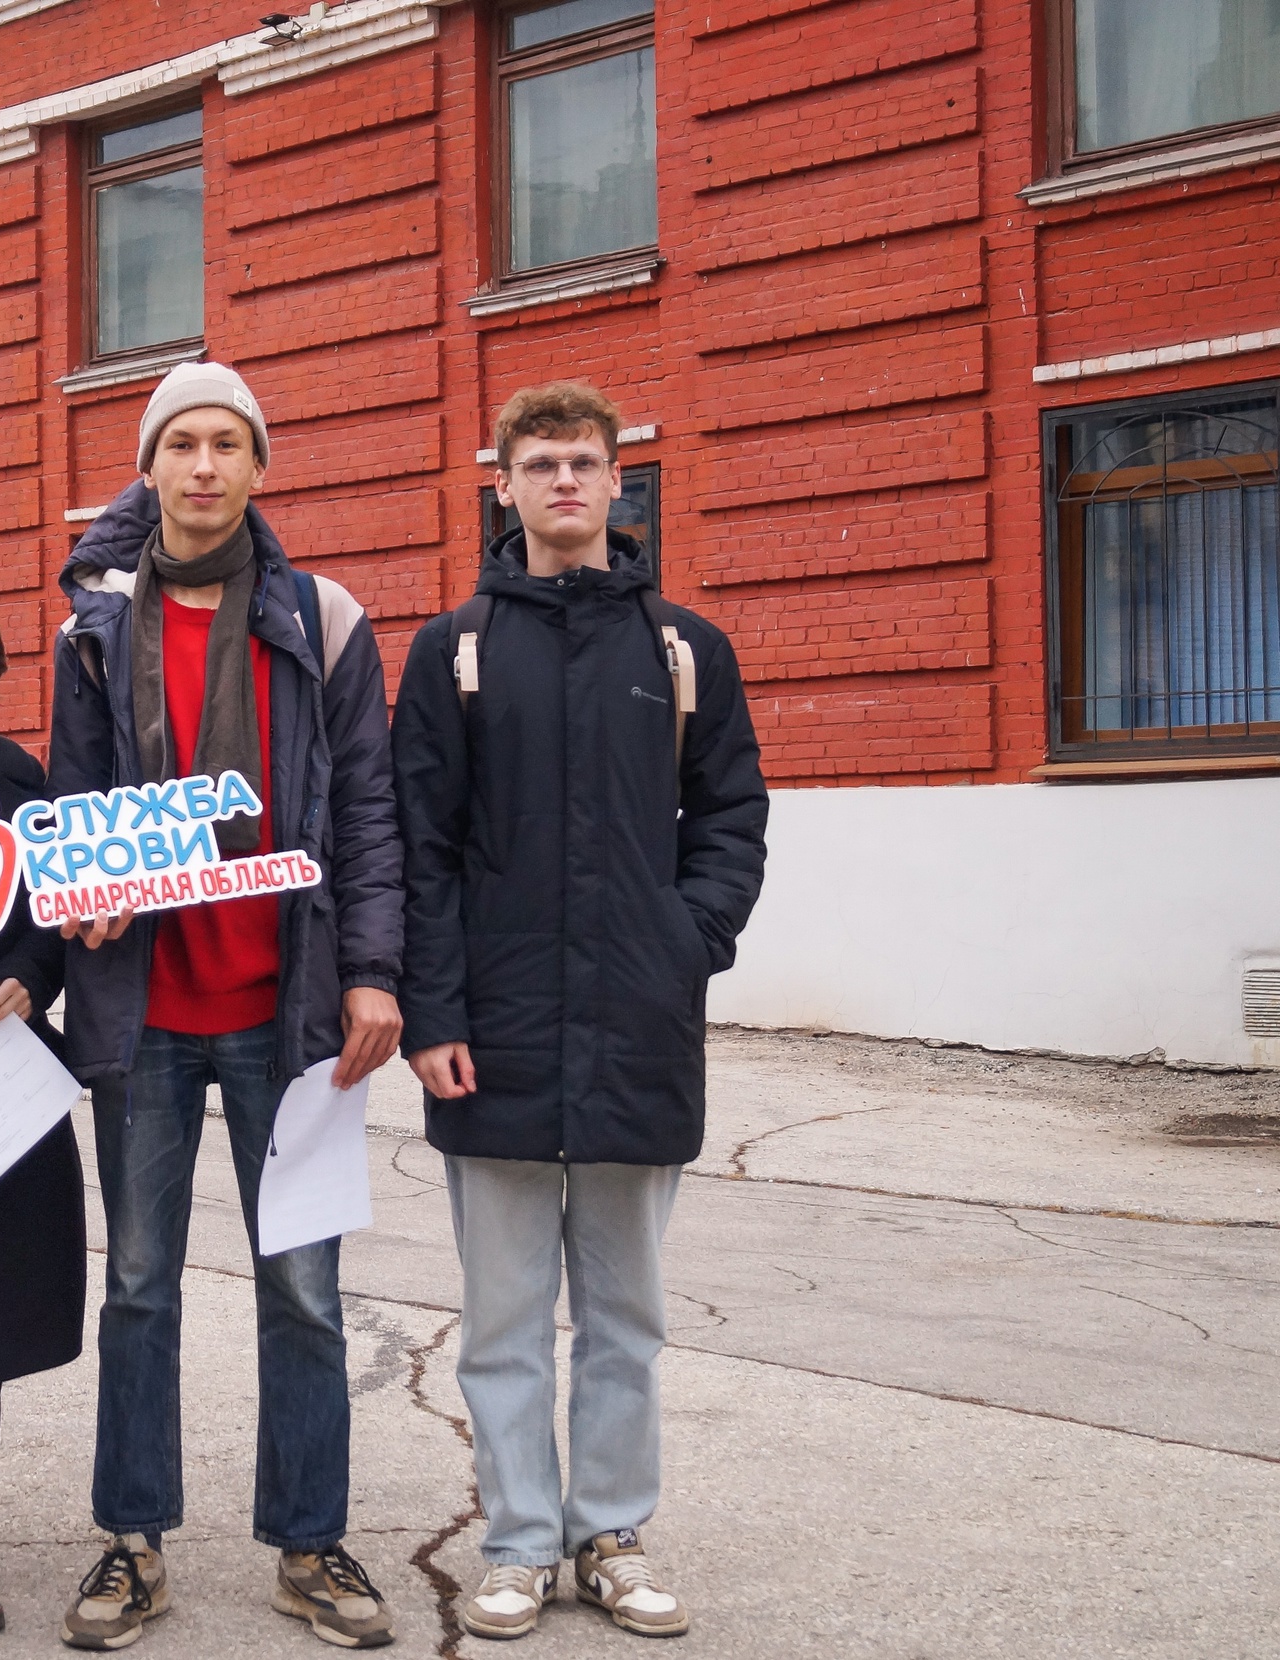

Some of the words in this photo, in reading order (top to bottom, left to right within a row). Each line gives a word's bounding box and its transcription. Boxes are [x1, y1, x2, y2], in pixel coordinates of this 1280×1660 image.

[20, 775, 257, 843] СЛУЖБА
[26, 823, 213, 888] КРОВИ
[36, 871, 195, 922] САМАРСКАЯ
[200, 855, 316, 896] ОБЛАСТЬ
